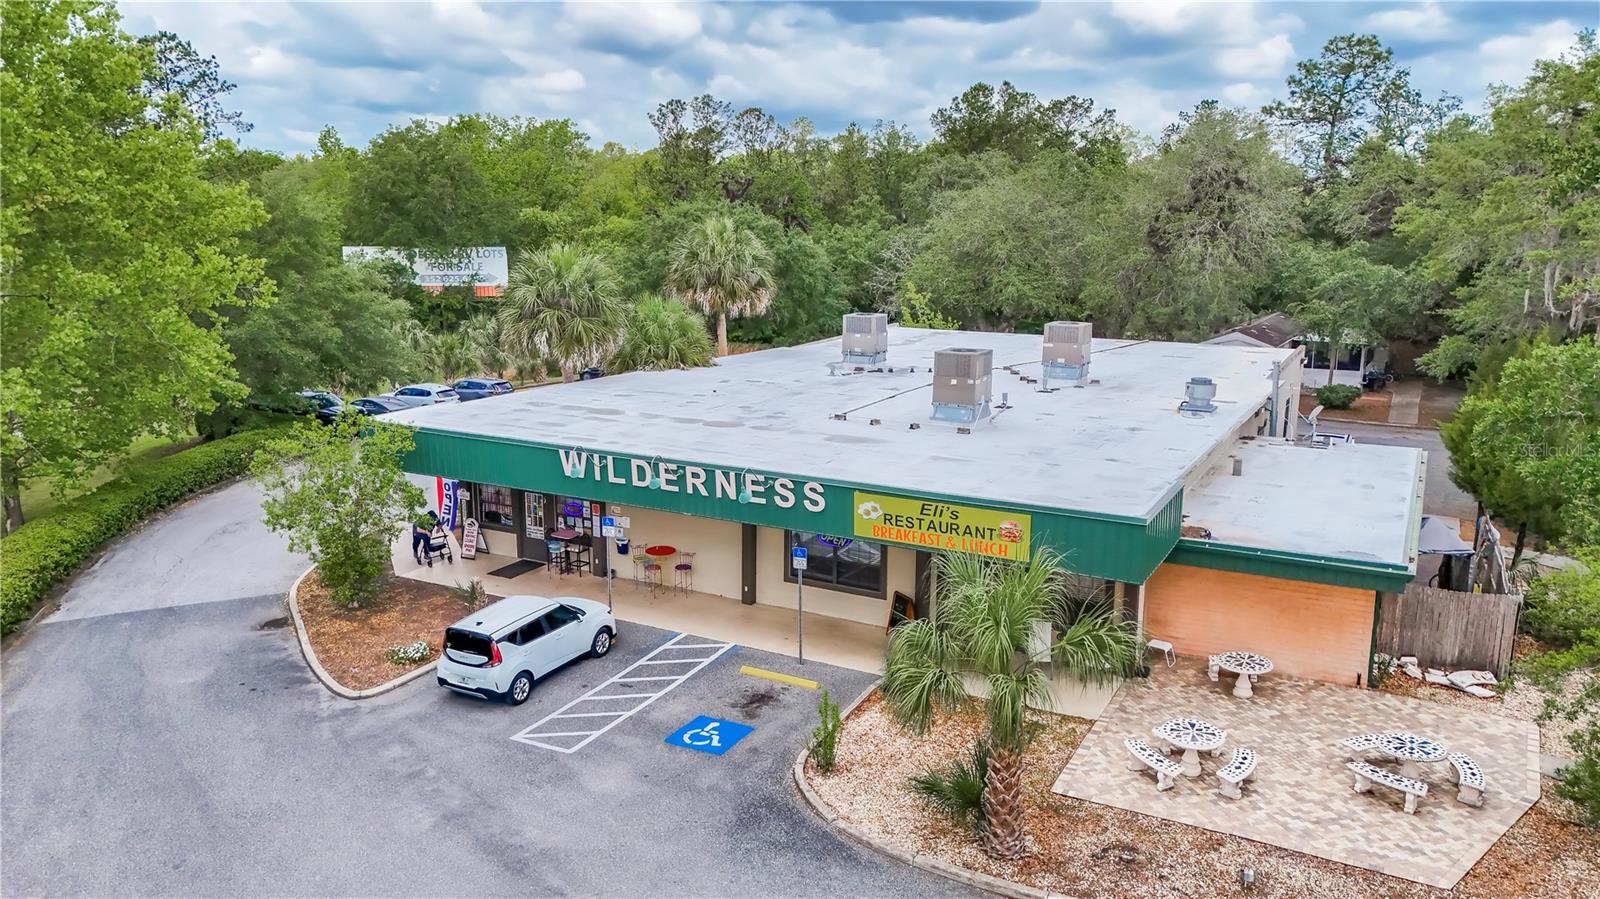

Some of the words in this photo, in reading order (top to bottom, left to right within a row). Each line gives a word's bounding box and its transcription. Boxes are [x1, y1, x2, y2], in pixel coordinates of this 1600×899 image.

[430, 262, 454, 272] FOR
[457, 262, 485, 272] SALE
[476, 249, 504, 259] LOTS
[559, 449, 826, 513] WILDERNESS
[872, 525, 942, 546] BREAKFAST
[946, 535, 958, 549] &
[962, 538, 1008, 557] LUNCH
[884, 513, 997, 541] RESTAURANT
